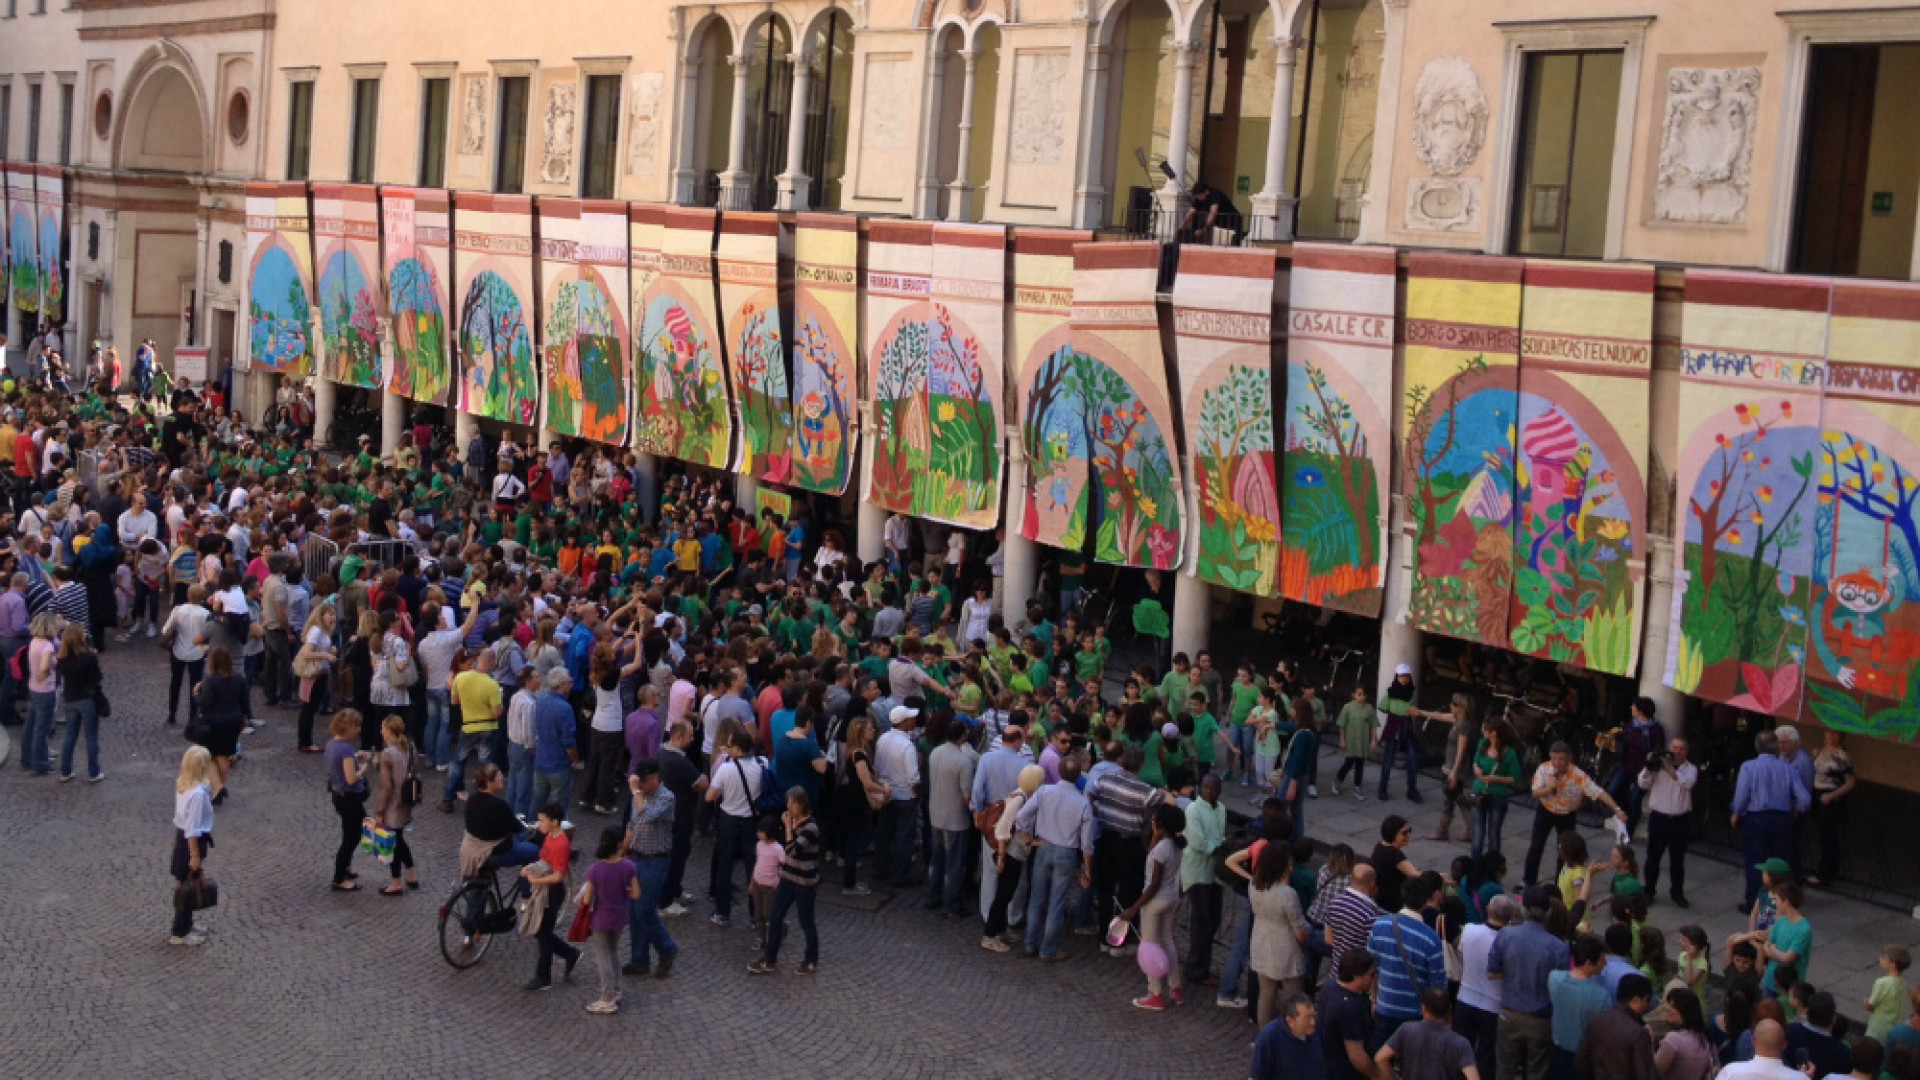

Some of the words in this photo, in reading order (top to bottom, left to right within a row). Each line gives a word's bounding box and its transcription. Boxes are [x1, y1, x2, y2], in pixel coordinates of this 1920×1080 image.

[1293, 311, 1357, 336] CASALE
[1361, 317, 1389, 339] CR.
[1408, 321, 1457, 342] BORGO
[1457, 329, 1485, 347] SAN
[1680, 348, 1753, 376] PRIMARIA
